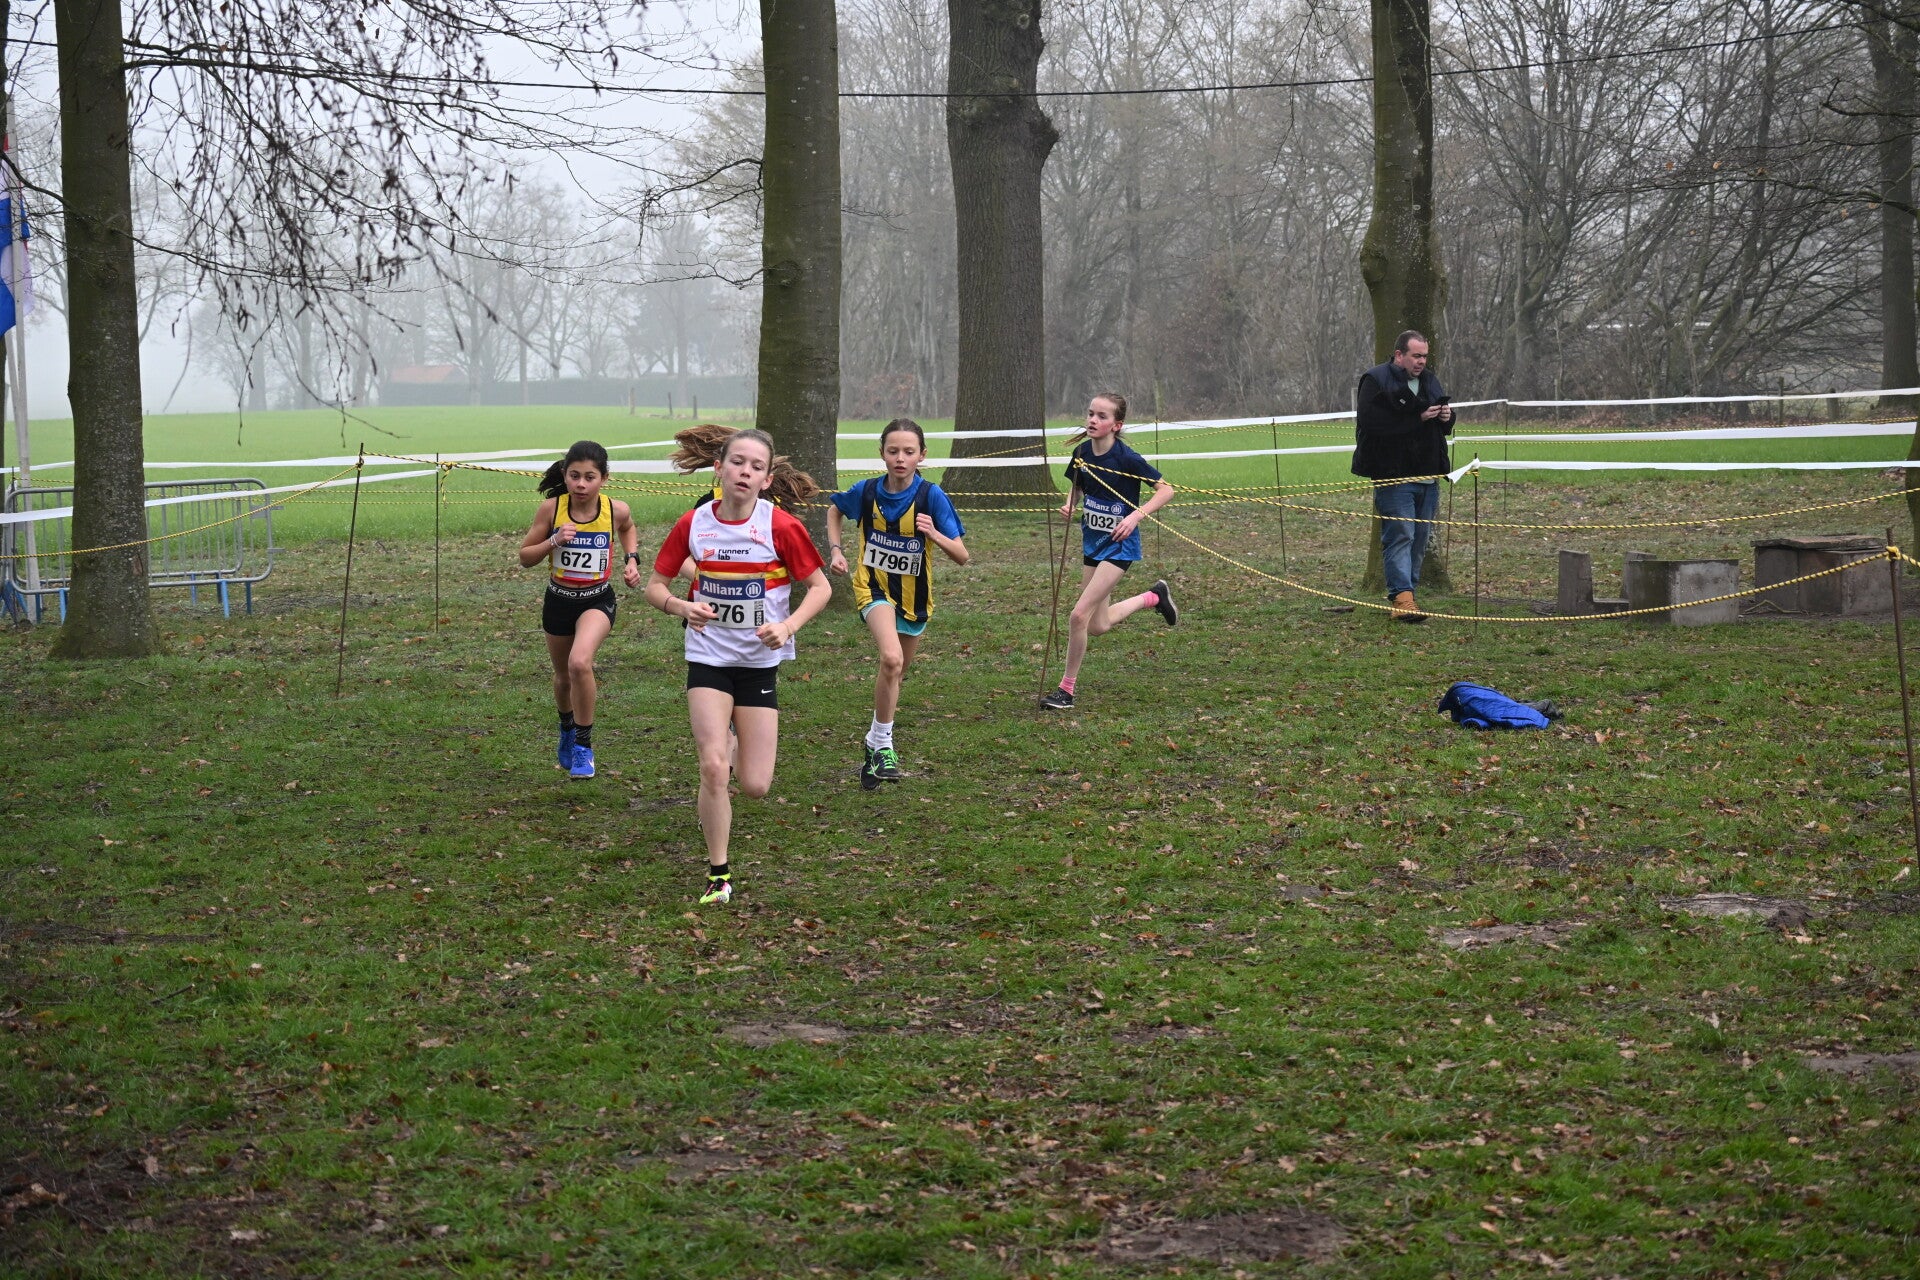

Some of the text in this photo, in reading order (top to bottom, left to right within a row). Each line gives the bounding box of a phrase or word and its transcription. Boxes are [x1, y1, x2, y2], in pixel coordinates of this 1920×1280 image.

[1085, 499, 1110, 511] Allianz
[1085, 512, 1114, 529] 1032
[870, 532, 905, 548] Allianz
[560, 551, 592, 568] 672
[869, 549, 909, 571] 1796
[558, 589, 577, 597] PRO
[579, 588, 600, 597] NIKE
[702, 581, 743, 596] Allianz
[707, 601, 745, 624] 276
